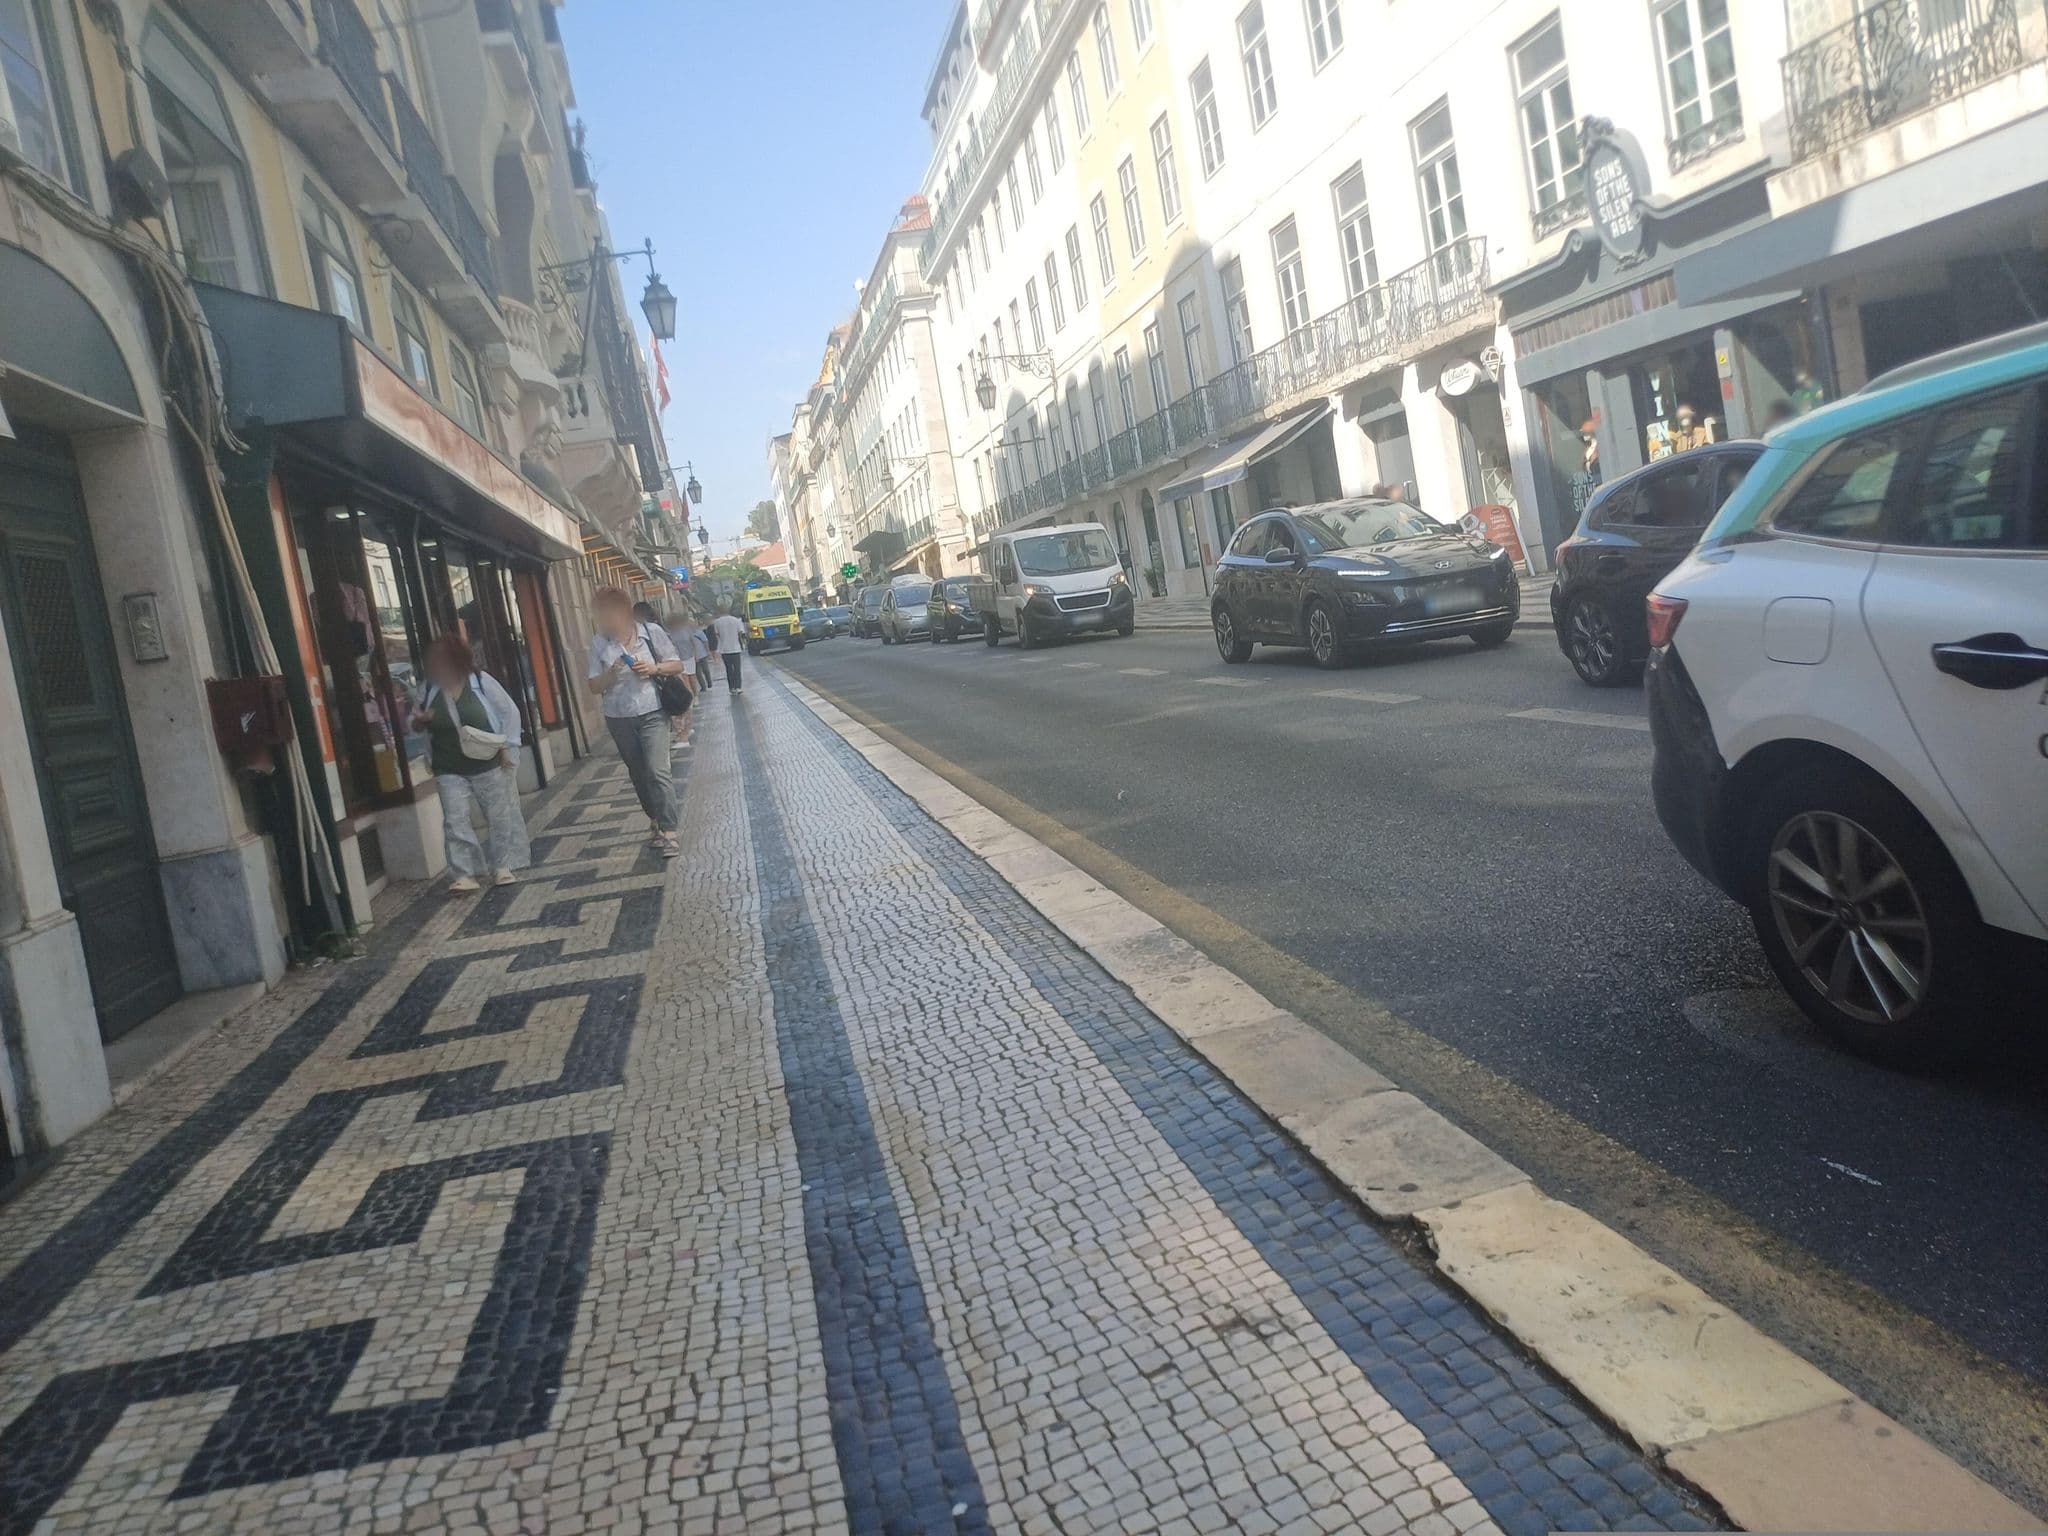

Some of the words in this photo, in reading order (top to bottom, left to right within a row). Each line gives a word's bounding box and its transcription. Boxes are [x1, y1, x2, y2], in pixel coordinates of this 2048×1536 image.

[1595, 159, 1622, 187] SONS
[1596, 186, 1610, 206] OF
[1609, 174, 1631, 200] THE
[1600, 192, 1633, 224] SILENT
[1611, 213, 1634, 239] AGE
[1572, 472, 1593, 486] SONS
